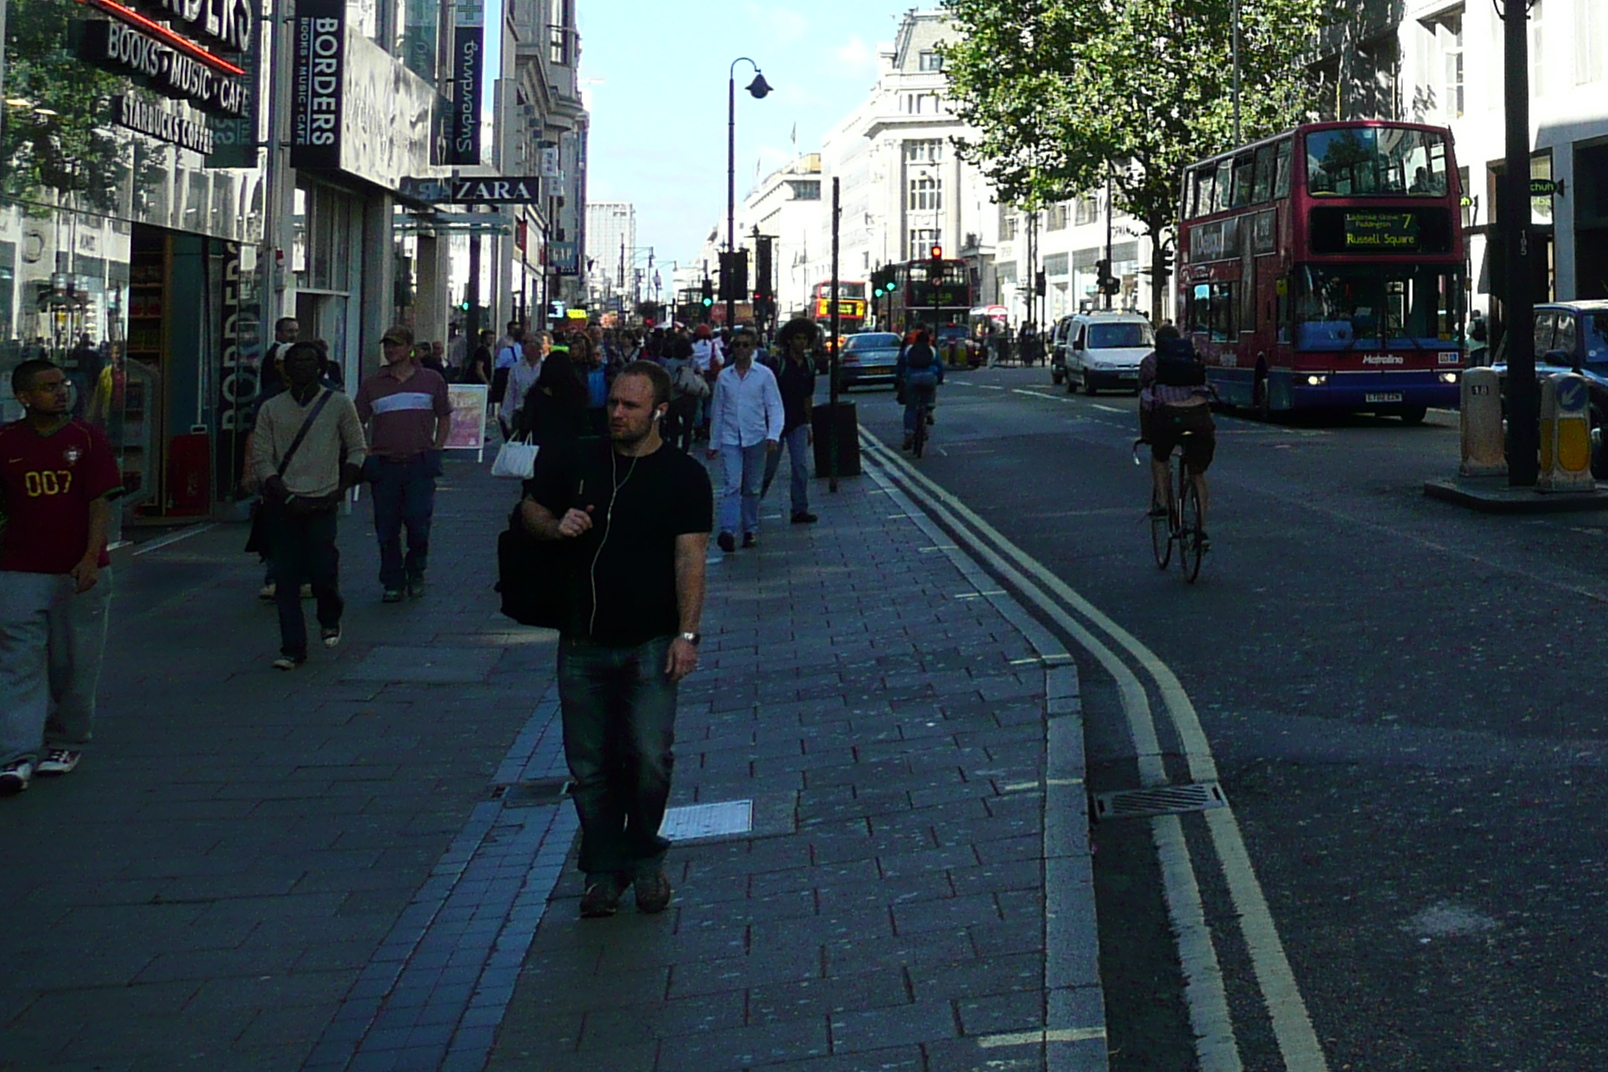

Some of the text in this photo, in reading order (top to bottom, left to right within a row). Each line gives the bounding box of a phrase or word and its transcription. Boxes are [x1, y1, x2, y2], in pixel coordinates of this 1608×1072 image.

[108, 20, 159, 76] BOOKS
[169, 51, 211, 99] MUSIC
[298, 66, 307, 103] MUSIC
[312, 17, 338, 145] BORDERS
[456, 39, 479, 153] Superdrug
[121, 95, 213, 155] STARBUCKS COFFEE
[455, 181, 533, 200] ZARA
[1530, 181, 1555, 193] chuh
[1401, 213, 1412, 229] 7
[1346, 232, 1416, 247] Russell Square
[552, 247, 573, 262] GAP
[1362, 354, 1404, 366] Metroline
